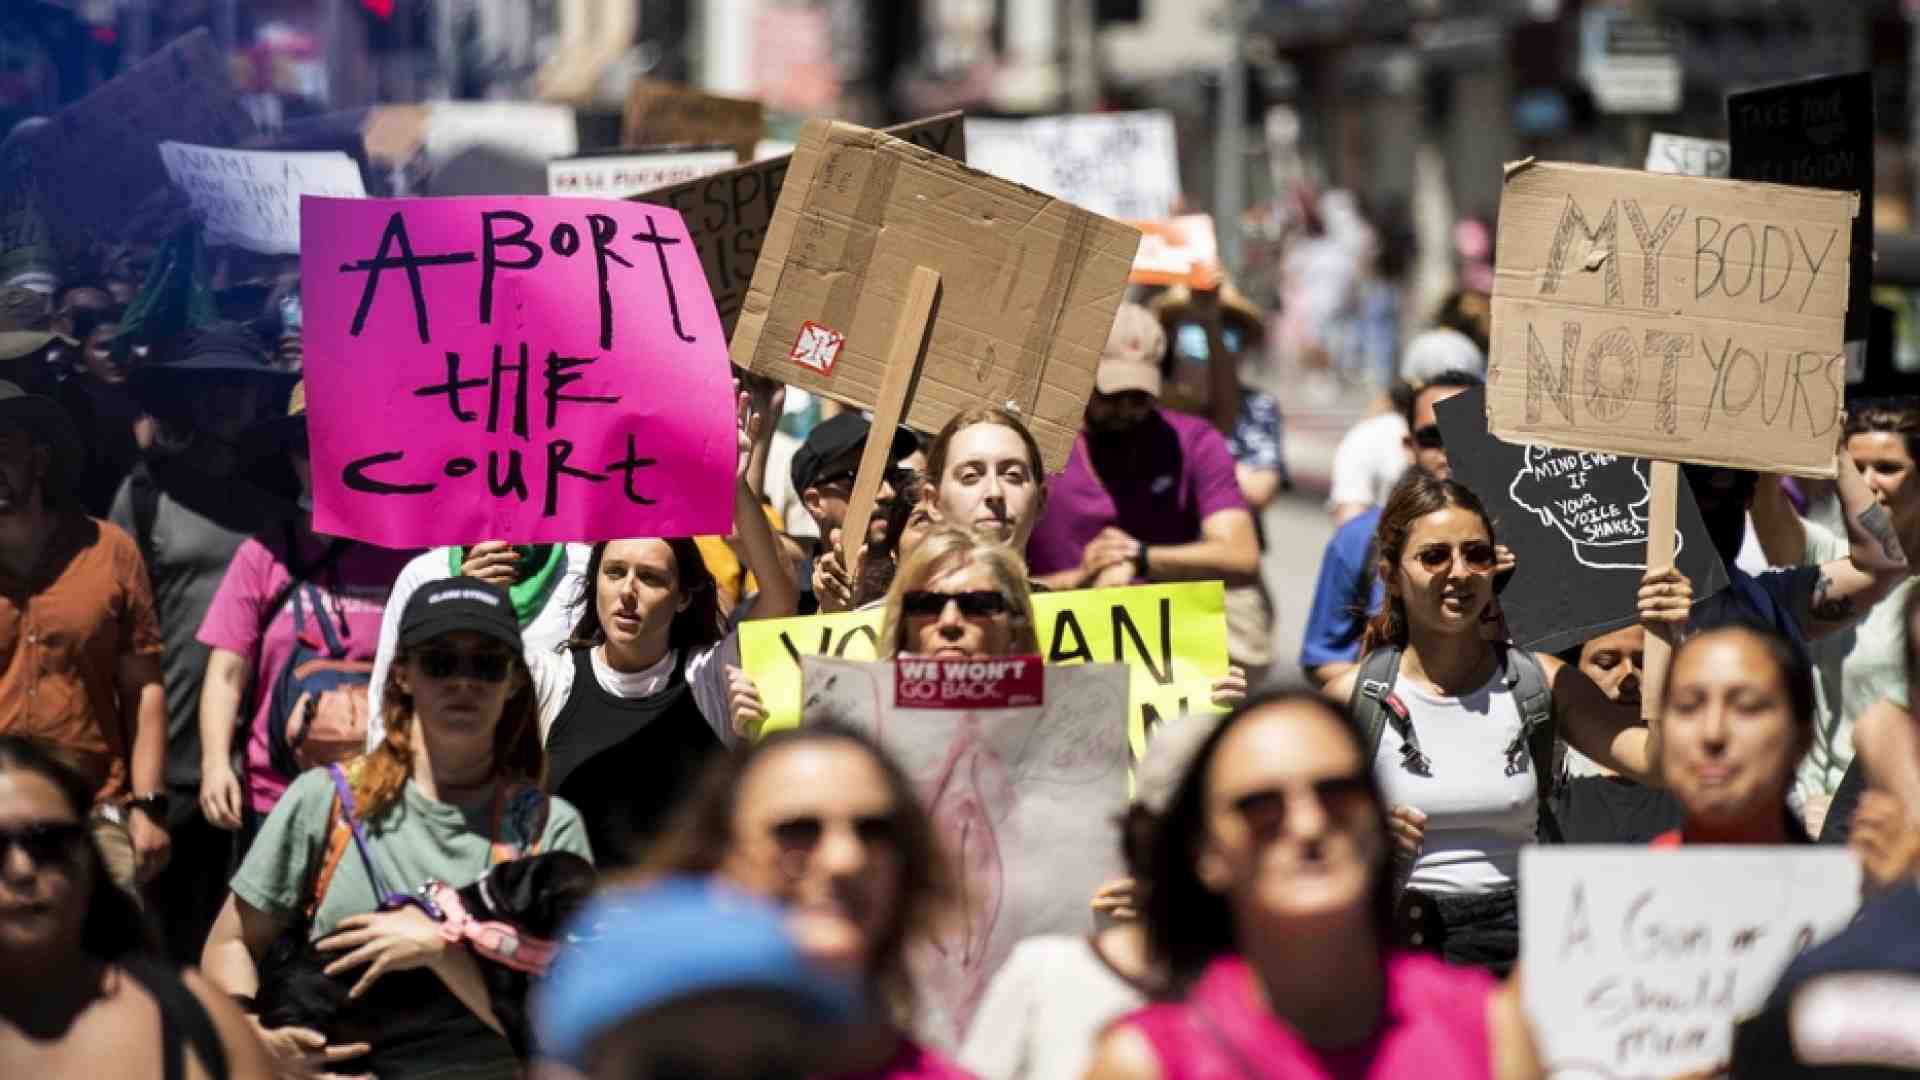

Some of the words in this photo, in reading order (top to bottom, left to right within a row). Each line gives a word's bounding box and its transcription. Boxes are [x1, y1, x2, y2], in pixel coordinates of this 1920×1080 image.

[1538, 194, 1688, 308] MY
[1695, 216, 1839, 313] BODY
[1525, 320, 1694, 434] NOT
[1702, 337, 1844, 439] YOURS
[1534, 455, 1578, 482] MIND
[1567, 471, 1588, 489] IF
[1553, 493, 1598, 516] YOUR
[1564, 503, 1621, 528] VOICE
[899, 661, 939, 680] WE
[943, 660, 1027, 681] WON'T
[899, 680, 938, 699] GO
[1558, 879, 1595, 962] A
